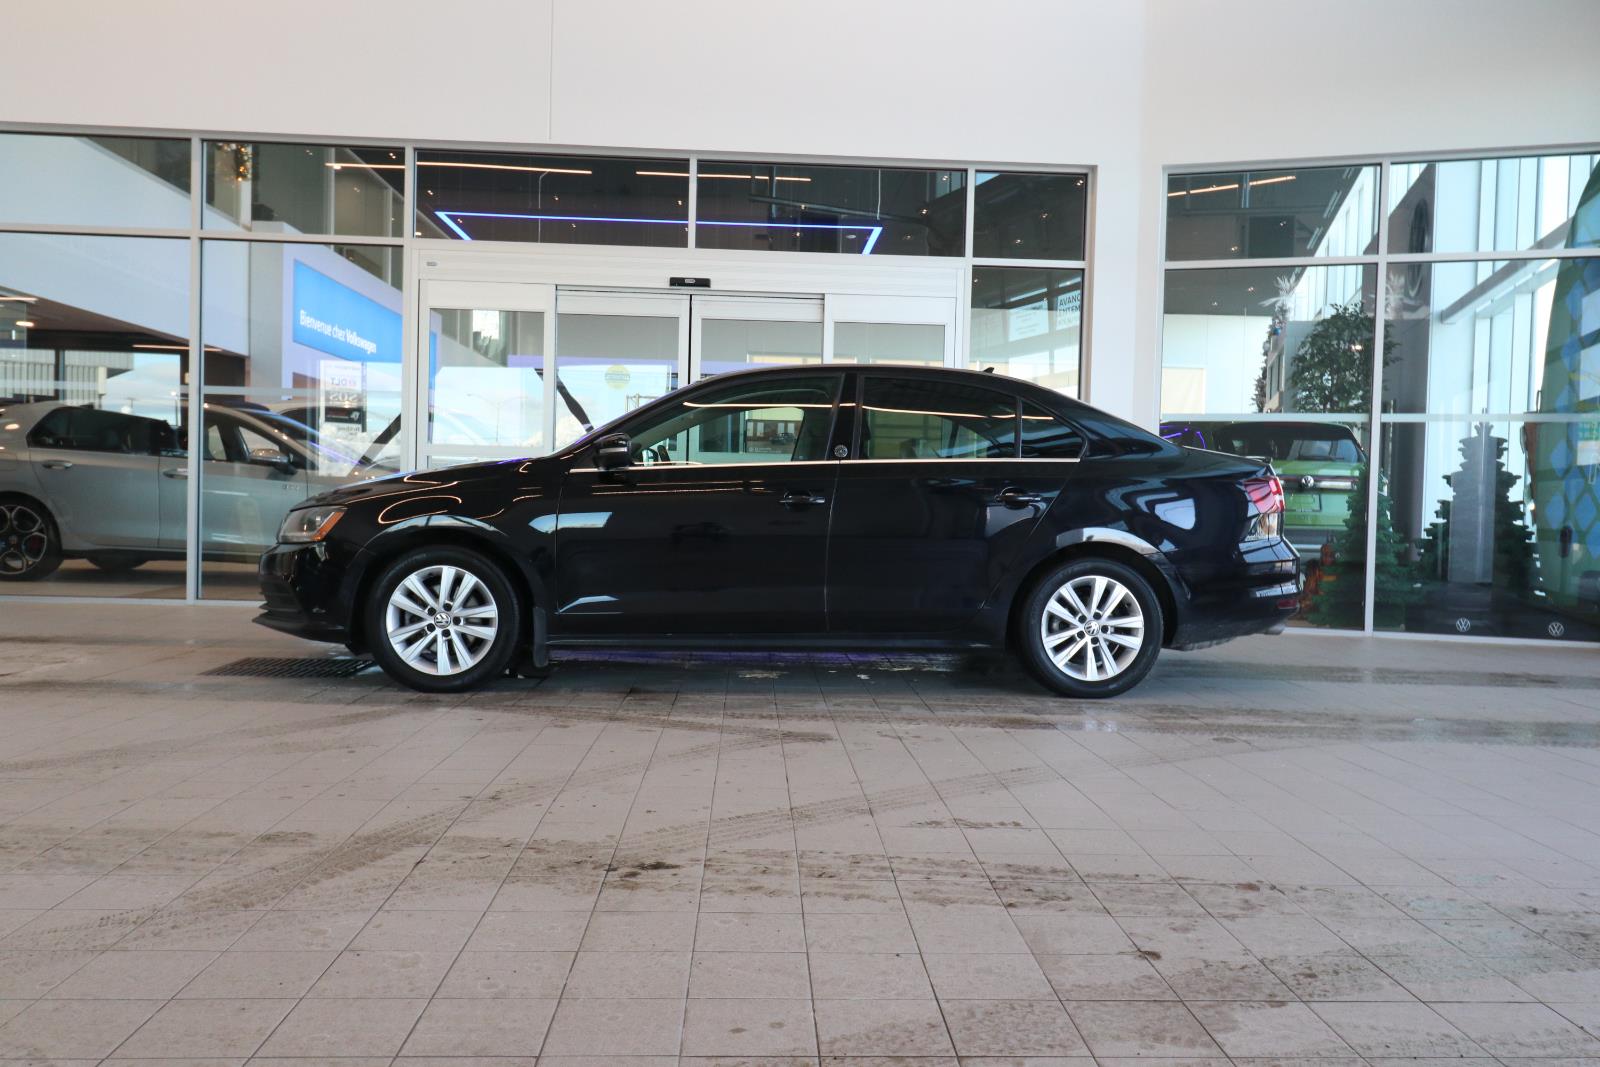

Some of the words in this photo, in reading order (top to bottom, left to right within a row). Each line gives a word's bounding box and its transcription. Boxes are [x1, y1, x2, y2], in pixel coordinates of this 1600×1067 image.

[300, 310, 332, 337] Bienvenue
[332, 324, 346, 342] chez
[346, 328, 377, 354] Volkswagen
